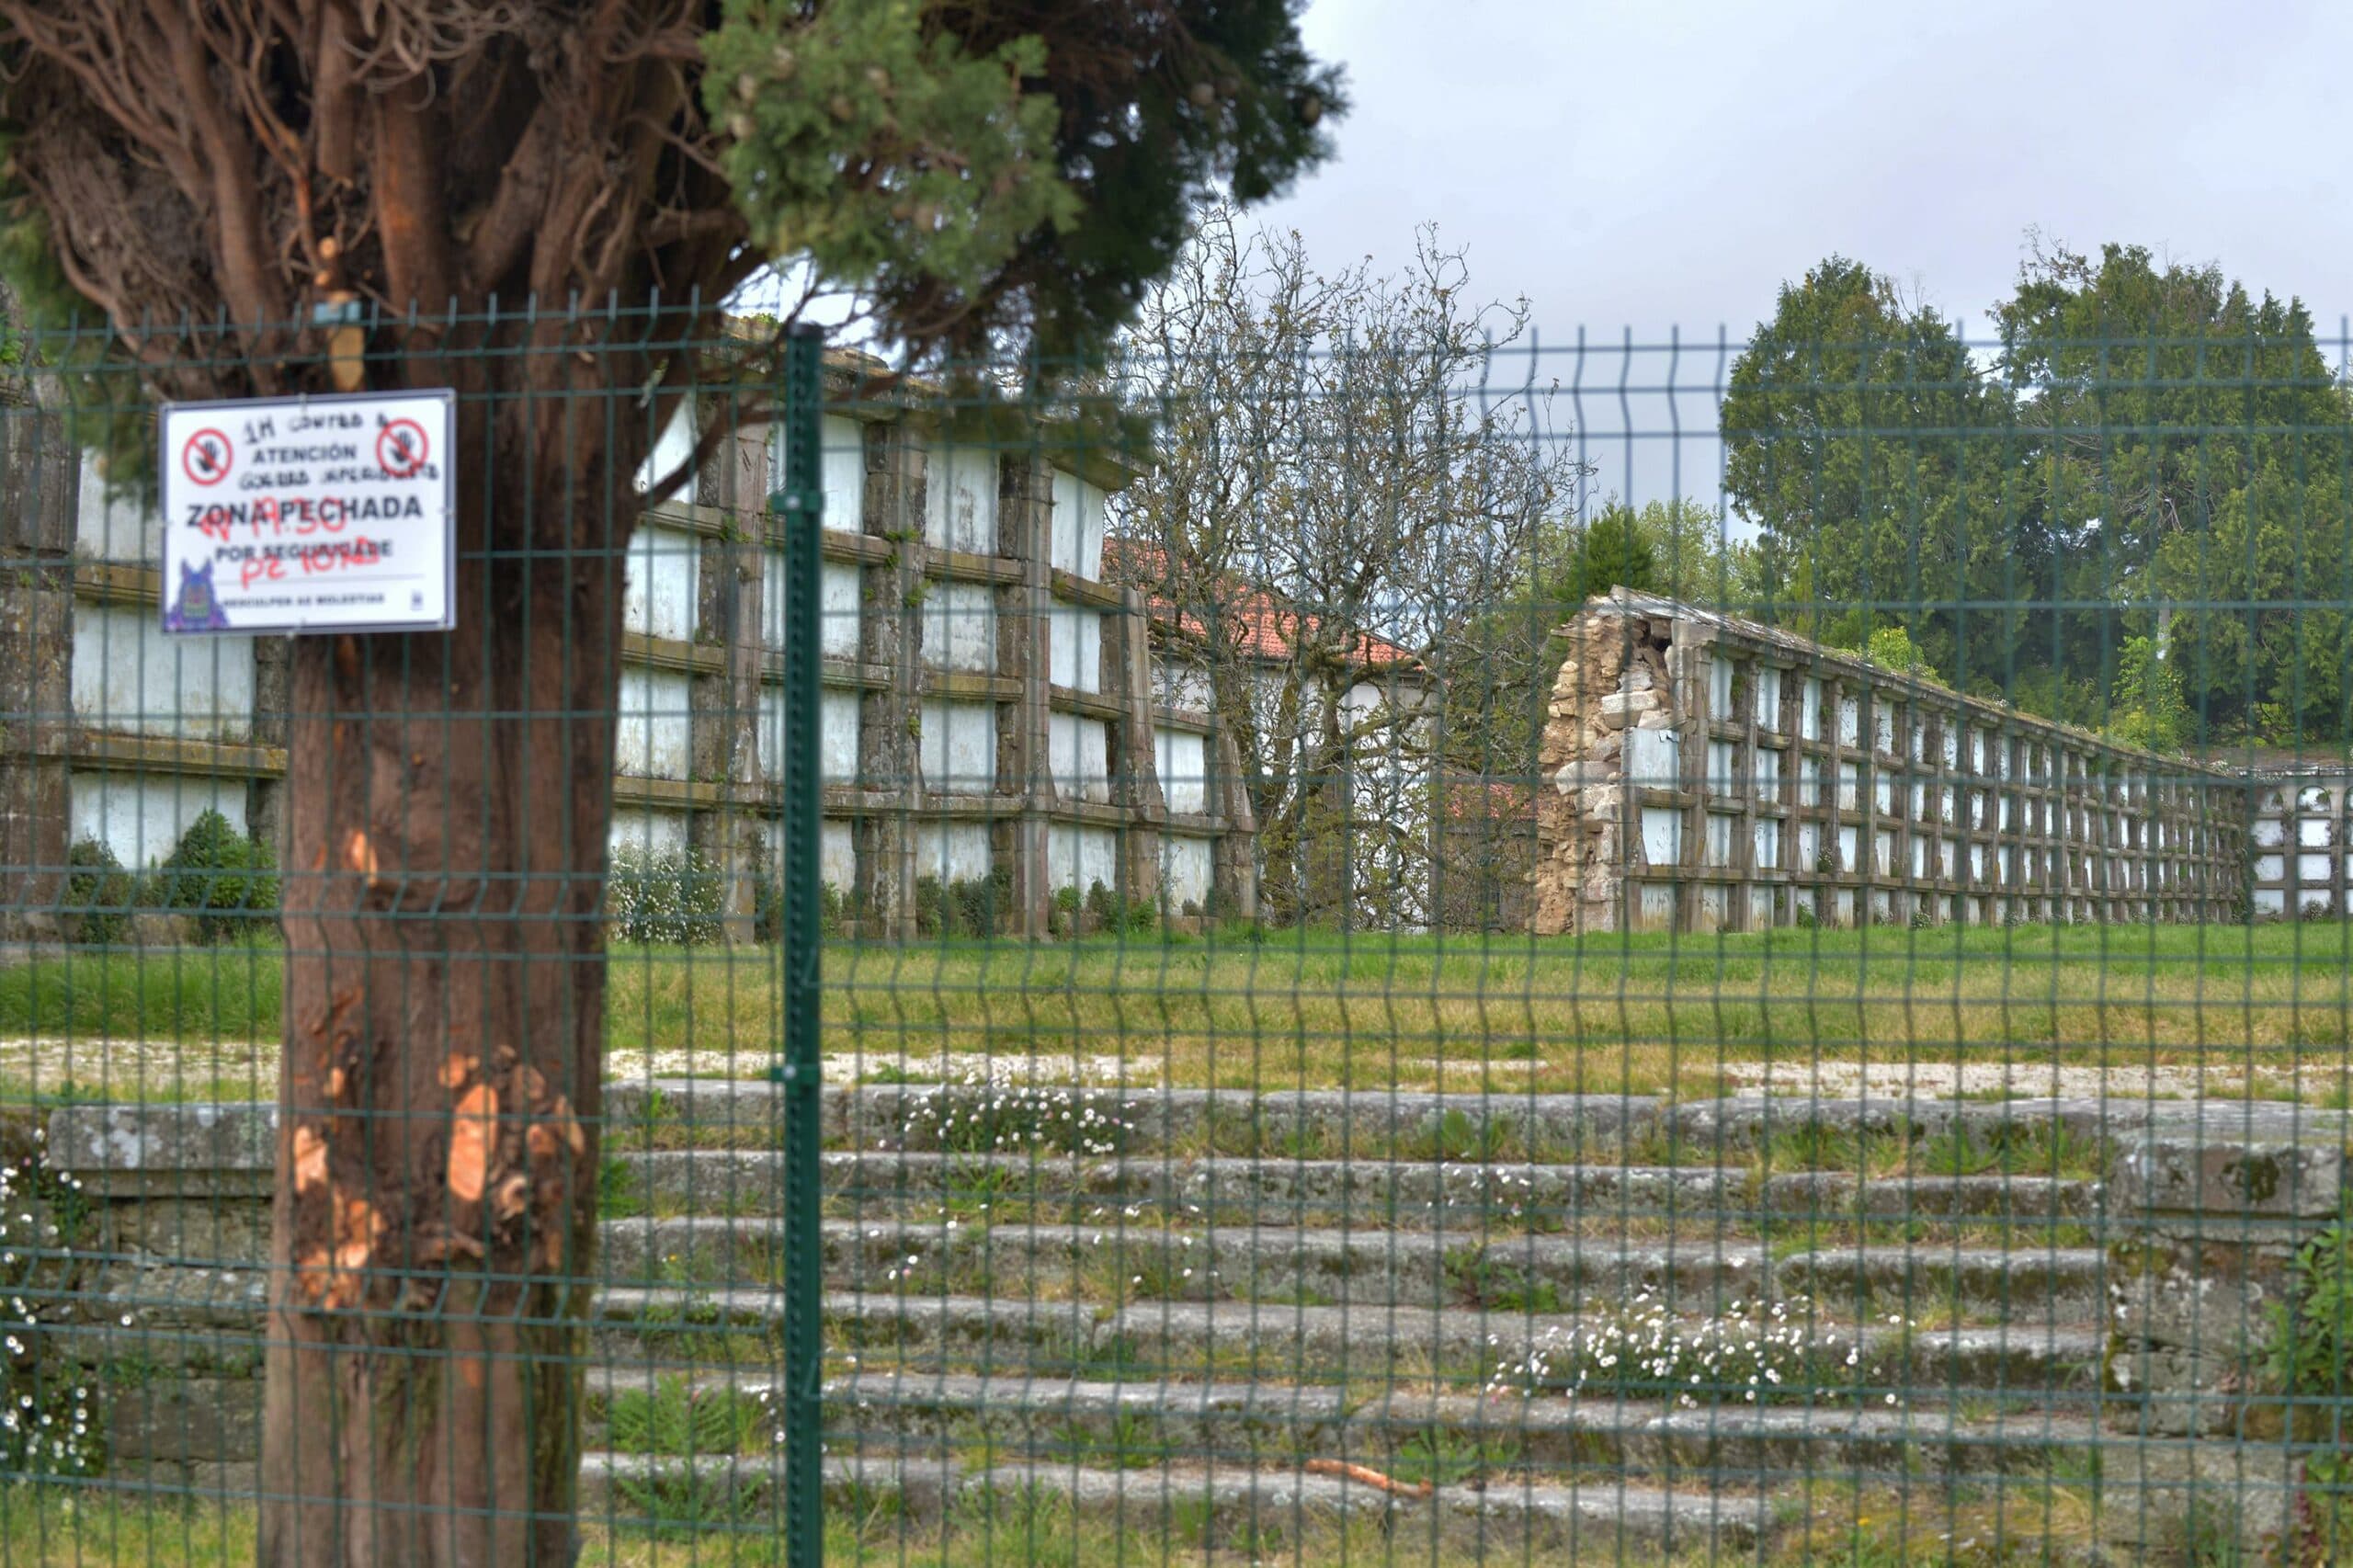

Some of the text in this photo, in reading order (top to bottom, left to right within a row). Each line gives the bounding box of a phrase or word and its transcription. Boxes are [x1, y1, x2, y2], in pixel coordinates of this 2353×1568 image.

[252, 443, 358, 464] ATENCIÓN
[187, 501, 268, 528] ZONA
[280, 495, 423, 524] PECHADA
[216, 543, 256, 562] POR
